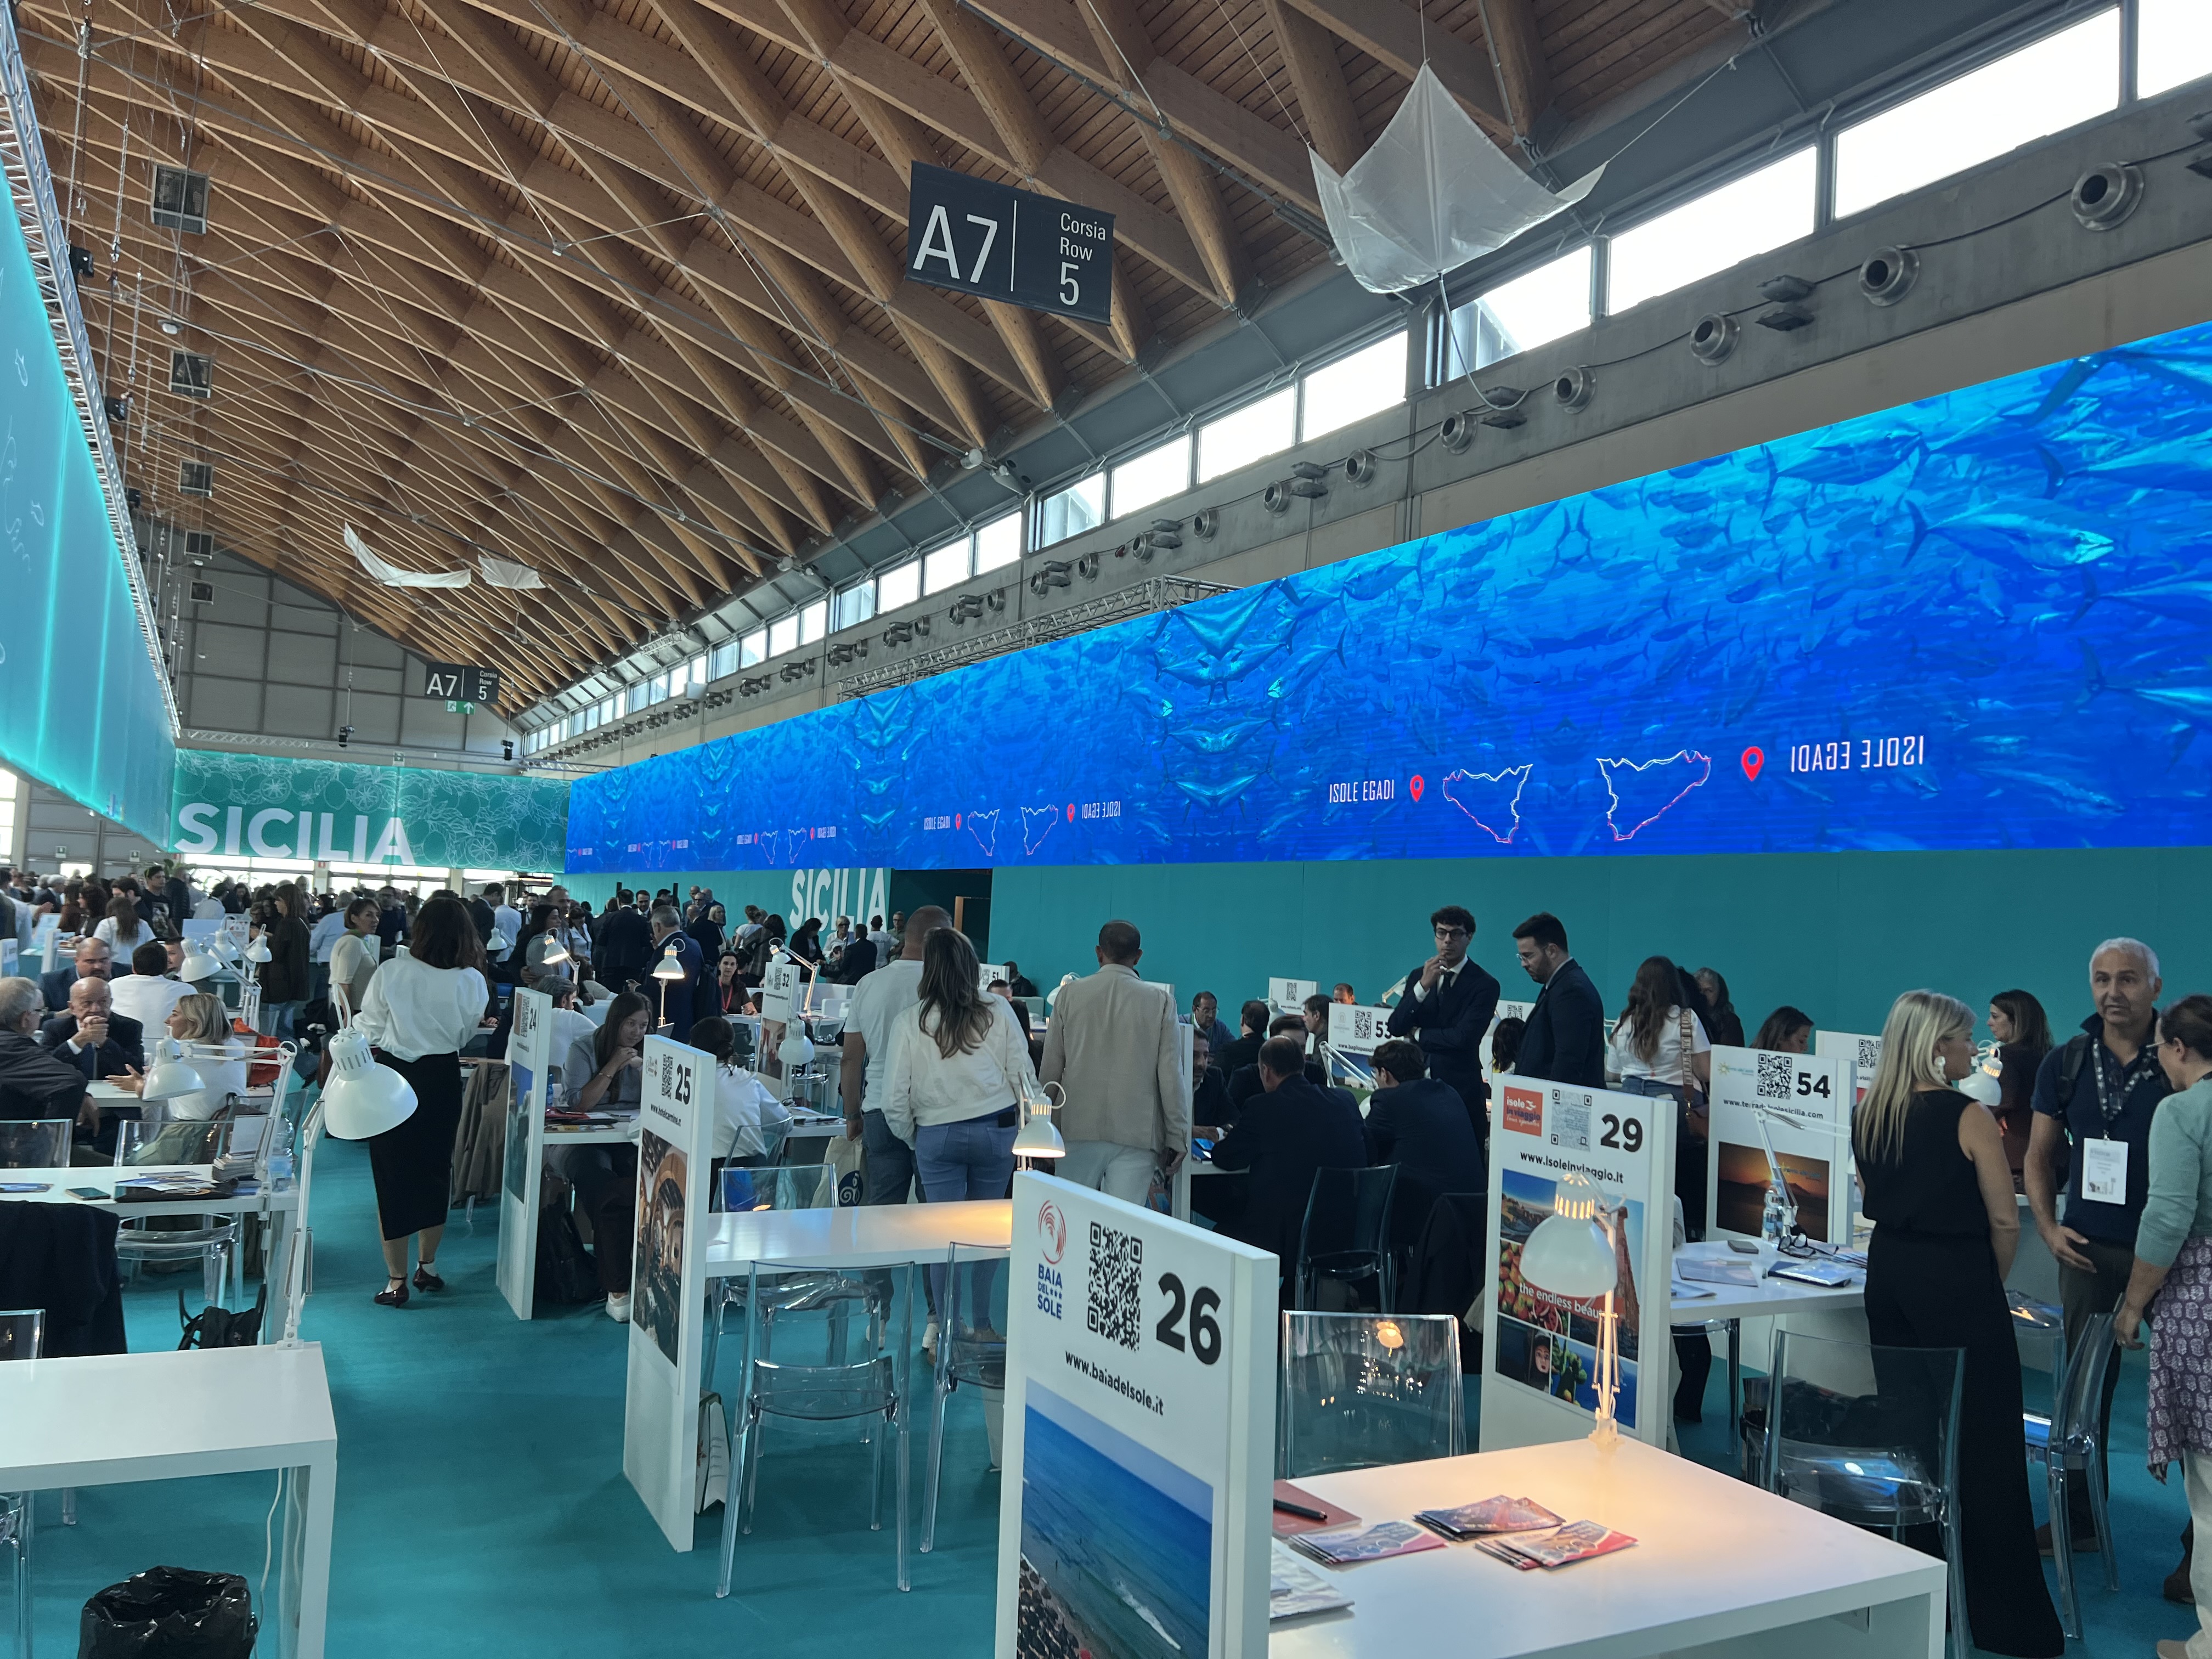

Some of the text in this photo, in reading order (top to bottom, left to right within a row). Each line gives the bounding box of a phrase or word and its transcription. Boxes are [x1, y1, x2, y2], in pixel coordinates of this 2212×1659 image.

[1060, 213, 1106, 241] Corsia
[913, 205, 997, 284] A7
[1059, 237, 1093, 261] Row
[1059, 262, 1080, 306] 5
[426, 673, 458, 697] A7
[479, 670, 498, 679] Corsia
[478, 686, 487, 701] 5
[1329, 779, 1395, 804] ISOLE EGADI
[173, 802, 416, 866] SICILIA
[924, 816, 936, 830] ISOLE
[789, 867, 888, 933] SICILIA
[782, 973, 789, 988] 32
[529, 1007, 537, 1032] 24
[675, 1064, 691, 1105] 25
[1797, 1071, 1831, 1099] 54
[1506, 1096, 1525, 1109] isole
[1506, 1106, 1541, 1122] in viaggio
[1600, 1114, 1643, 1153] 29
[1038, 1263, 1063, 1290] BAIA
[1038, 1281, 1049, 1295] DEL
[1037, 1294, 1062, 1321] SOLE
[1519, 1282, 1534, 1296] the
[1537, 1290, 1572, 1311] endless
[1156, 1272, 1222, 1365] 26
[1065, 1350, 1164, 1416] www.baiadelsole.it
